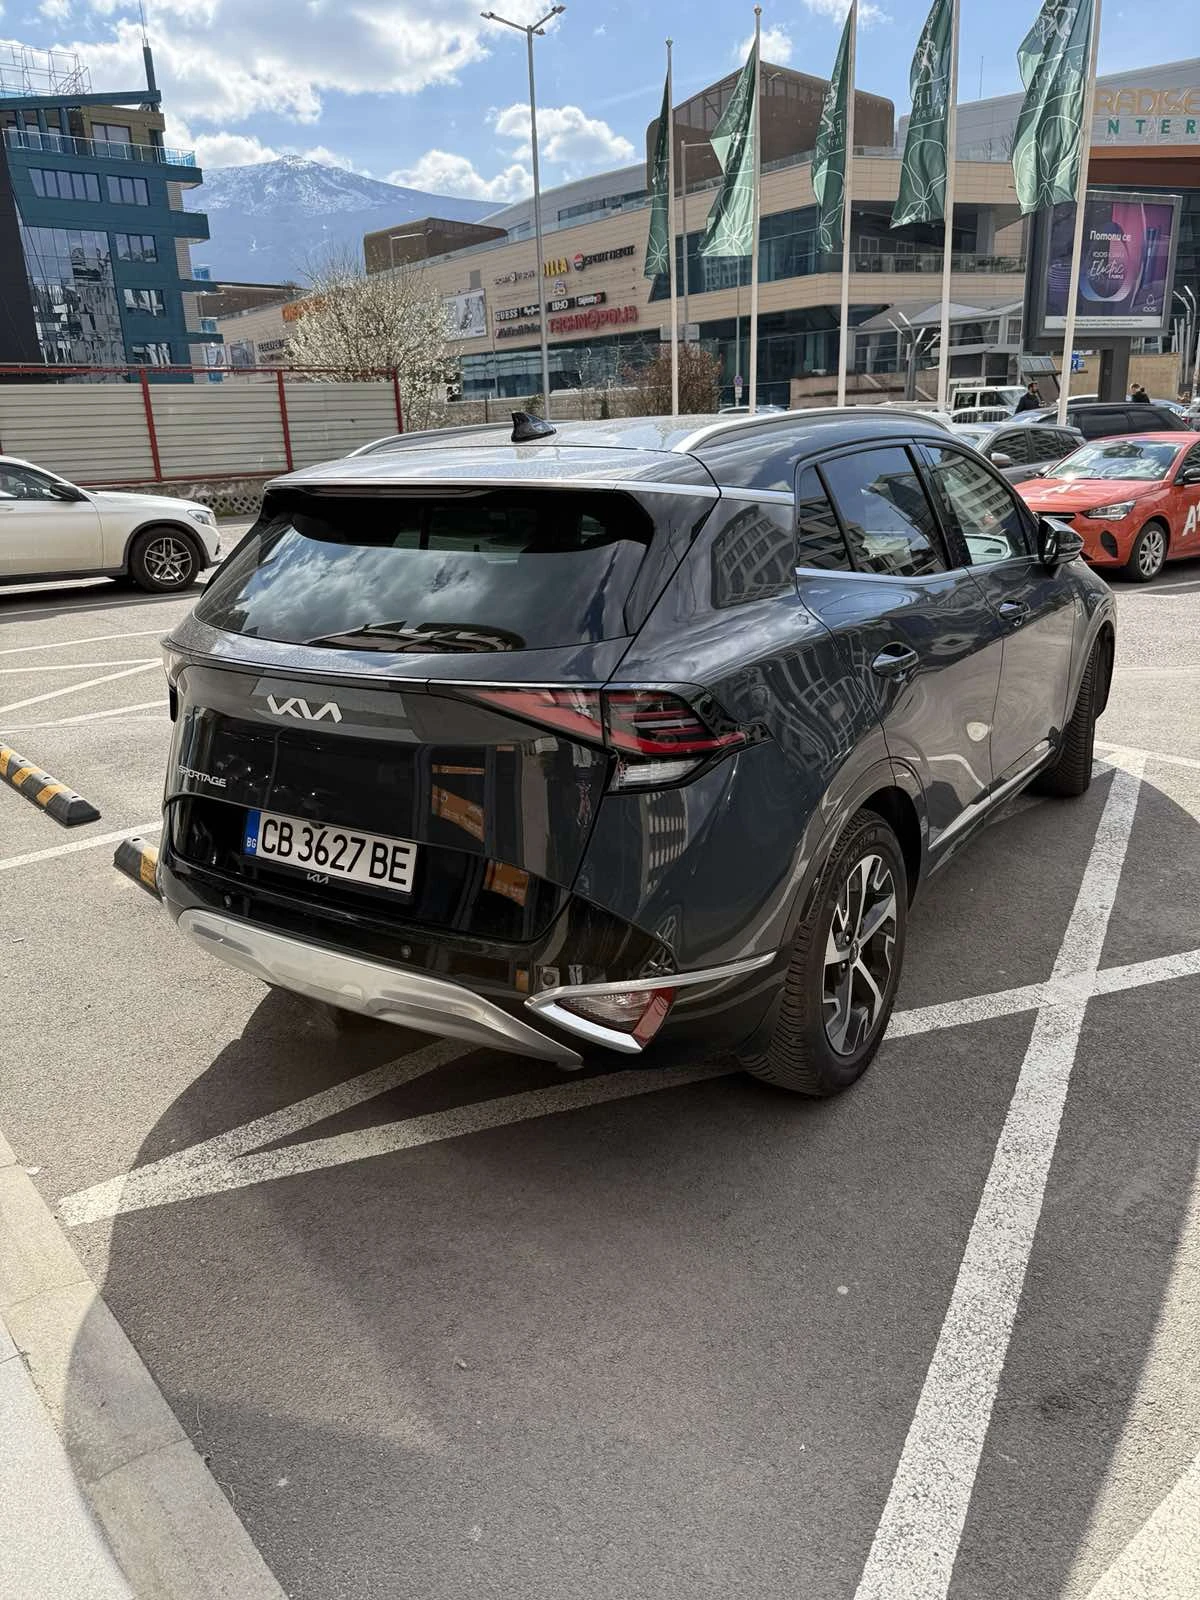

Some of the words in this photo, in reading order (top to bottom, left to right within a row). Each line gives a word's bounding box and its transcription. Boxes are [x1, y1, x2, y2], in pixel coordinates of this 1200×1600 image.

[1094, 88, 1200, 115] RADISE
[1108, 119, 1196, 134] NTER
[495, 308, 519, 322] GUESS
[266, 693, 343, 724] KIA
[178, 764, 227, 788] SPORTAGE
[246, 836, 257, 849] BG
[261, 819, 294, 857] CB
[298, 826, 367, 874] 3627
[369, 841, 411, 886] BE
